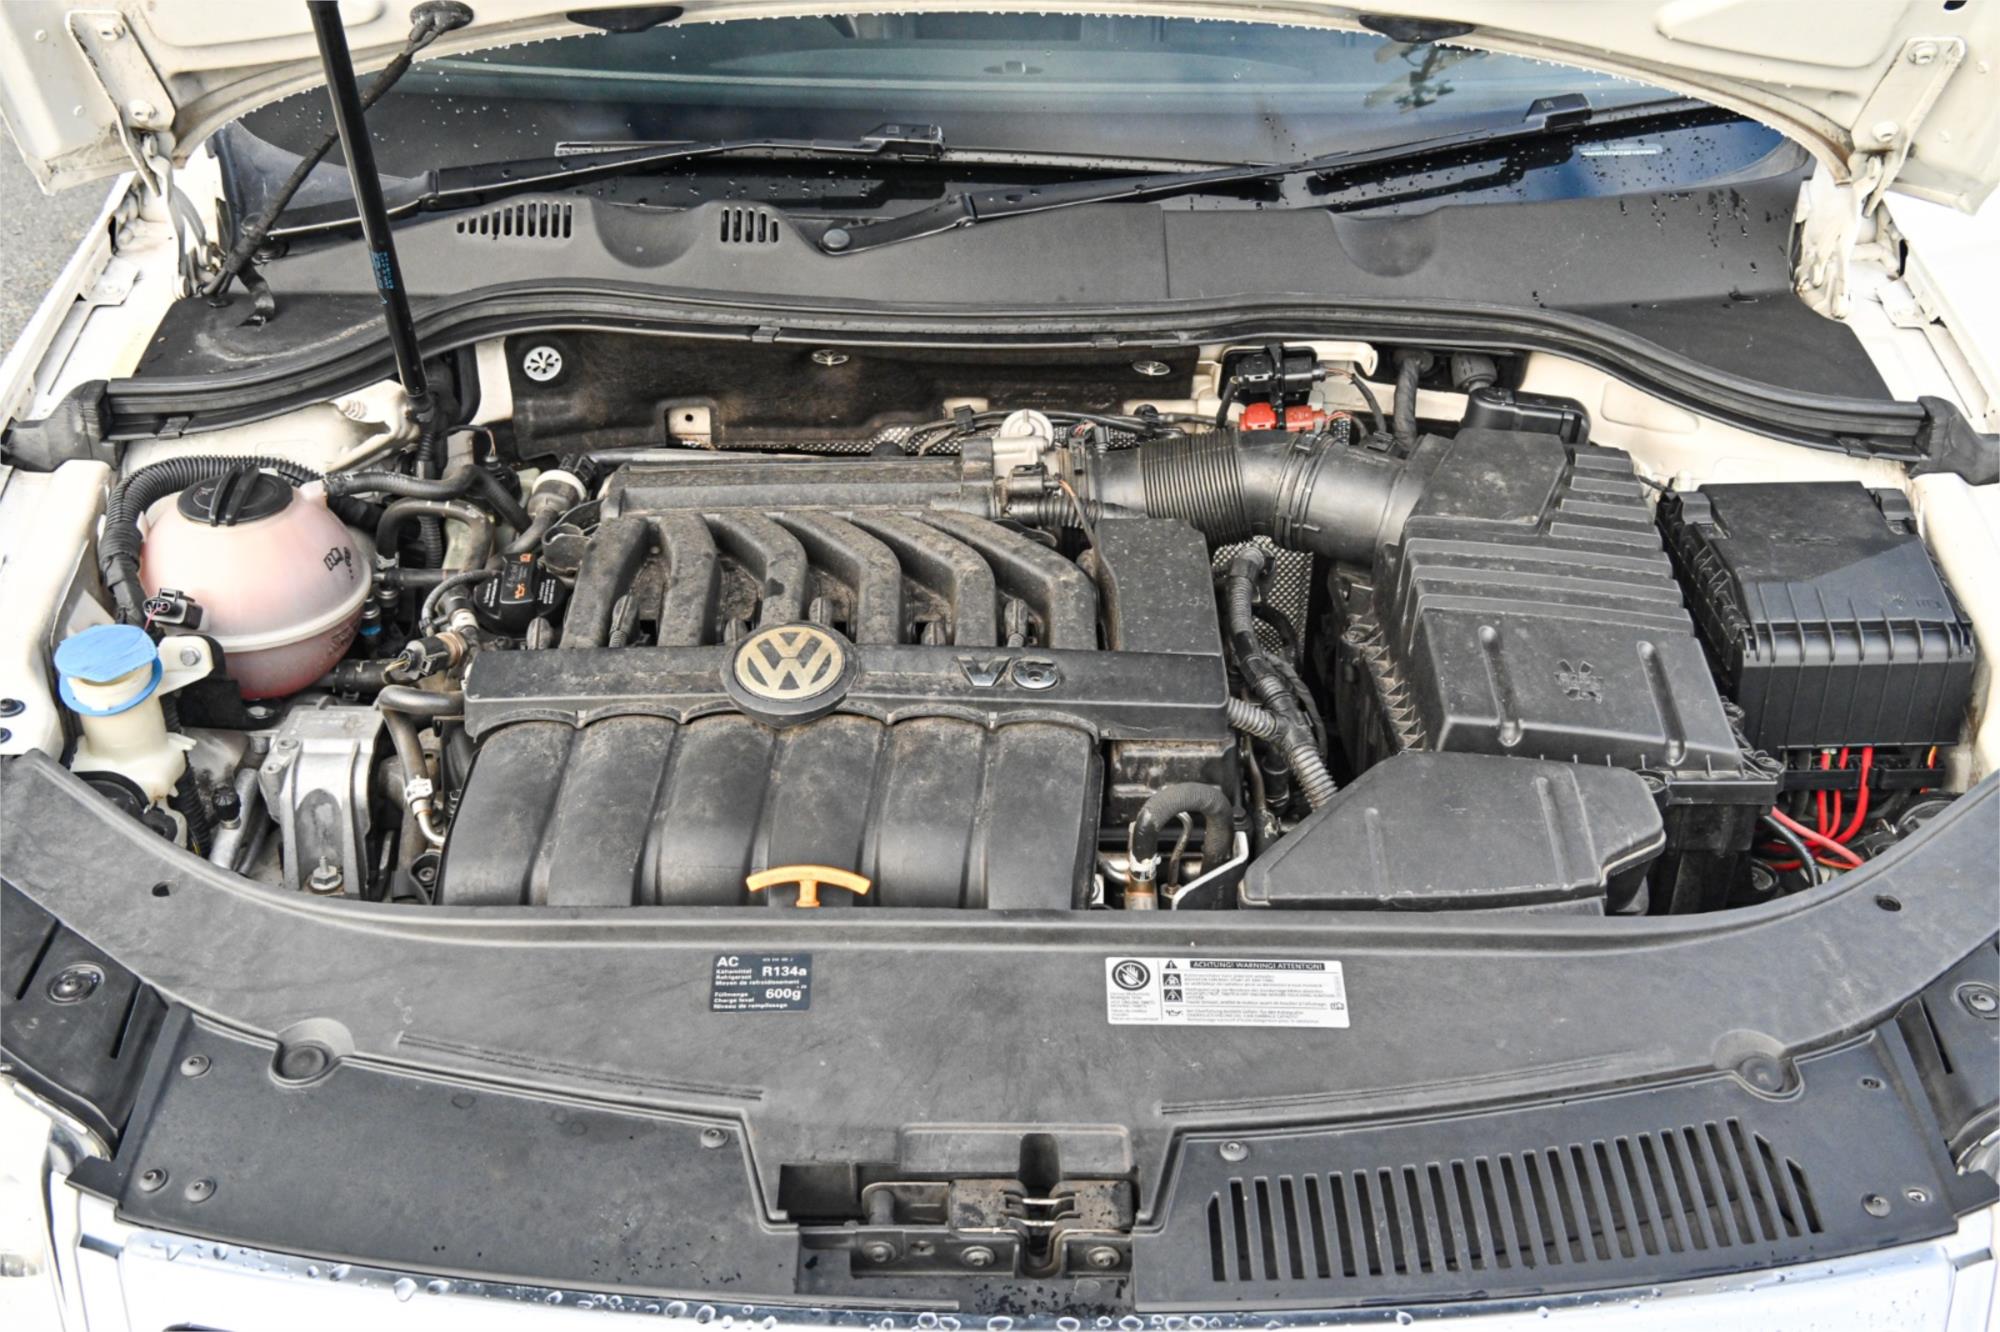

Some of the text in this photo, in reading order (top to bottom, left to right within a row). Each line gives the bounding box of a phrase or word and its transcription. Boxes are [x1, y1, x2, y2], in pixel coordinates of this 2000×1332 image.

[955, 655, 1059, 690] V6
[716, 956, 739, 967] AC
[762, 965, 807, 977] R134a
[765, 988, 801, 1001] 600g
